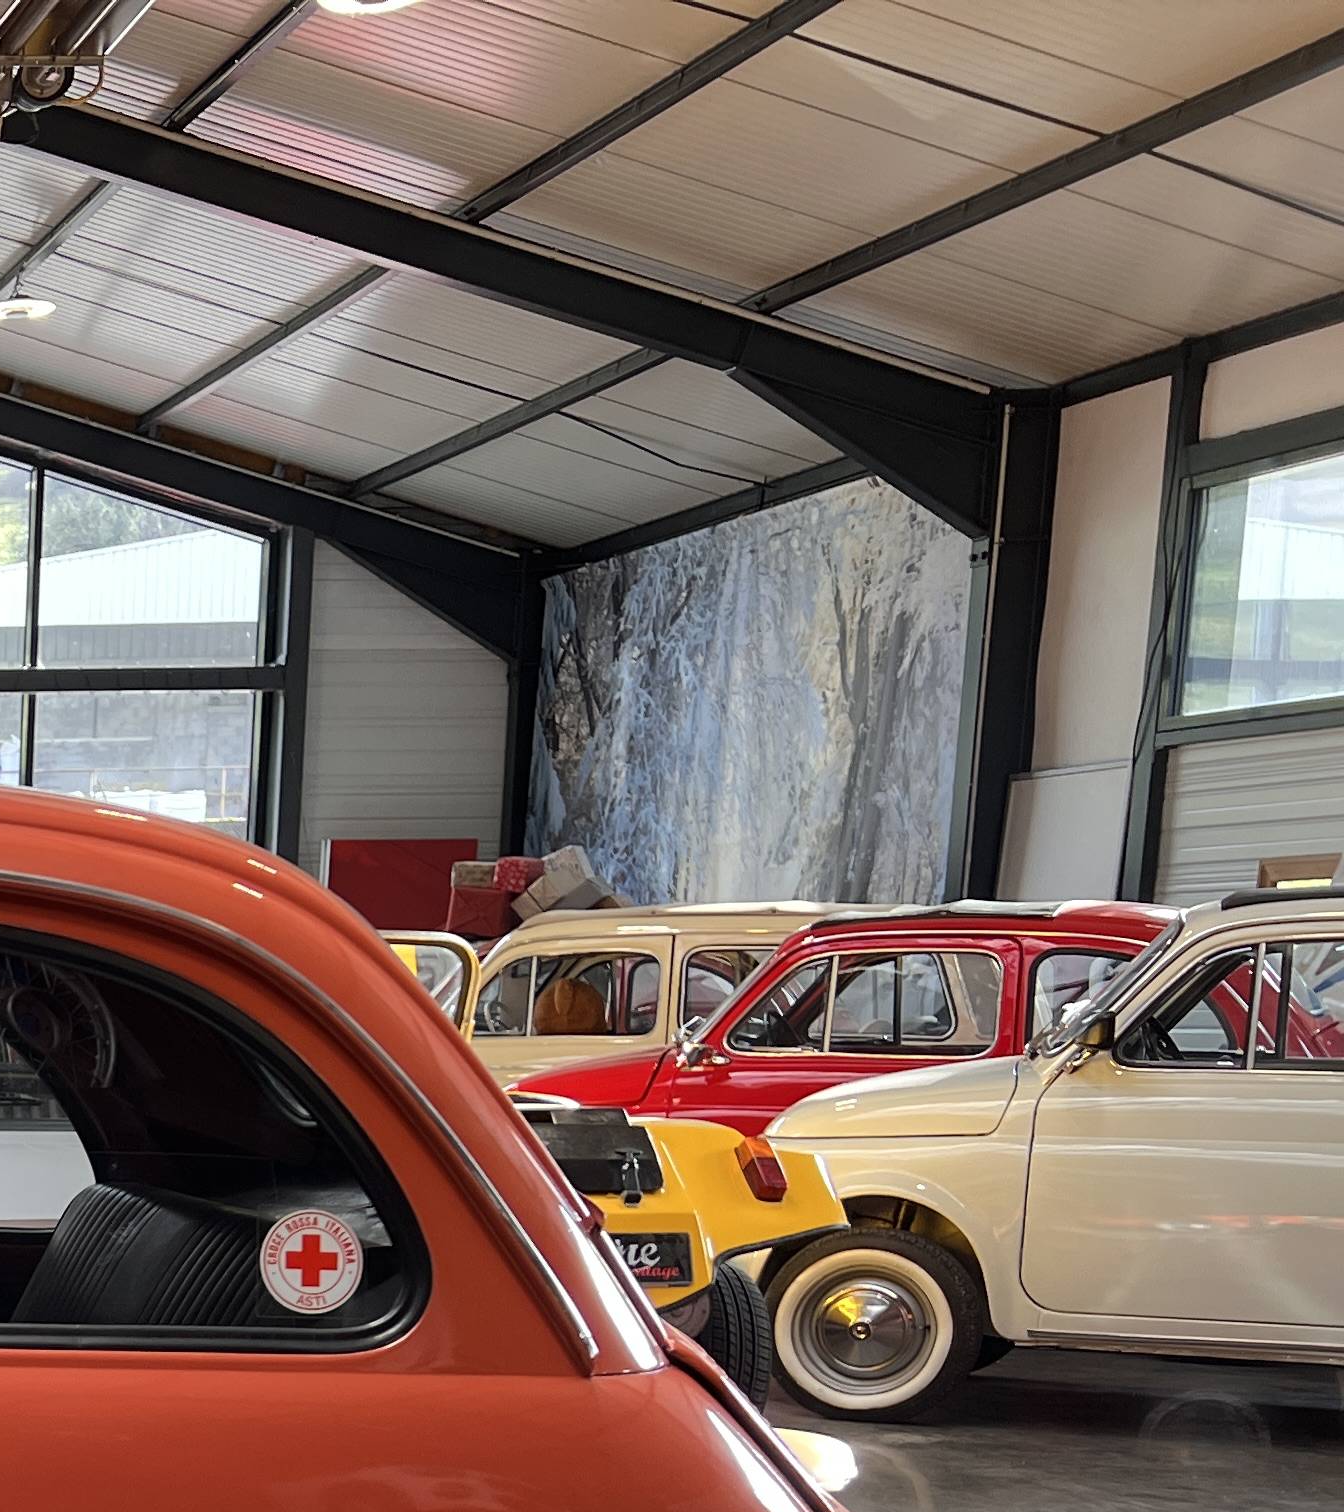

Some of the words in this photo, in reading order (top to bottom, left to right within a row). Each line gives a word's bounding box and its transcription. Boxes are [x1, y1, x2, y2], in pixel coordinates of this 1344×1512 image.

[266, 1232, 285, 1265] CROCE
[284, 1216, 318, 1233] ROSSA
[324, 1220, 356, 1265] ITALIANA
[295, 1295, 327, 1307] ASTI
